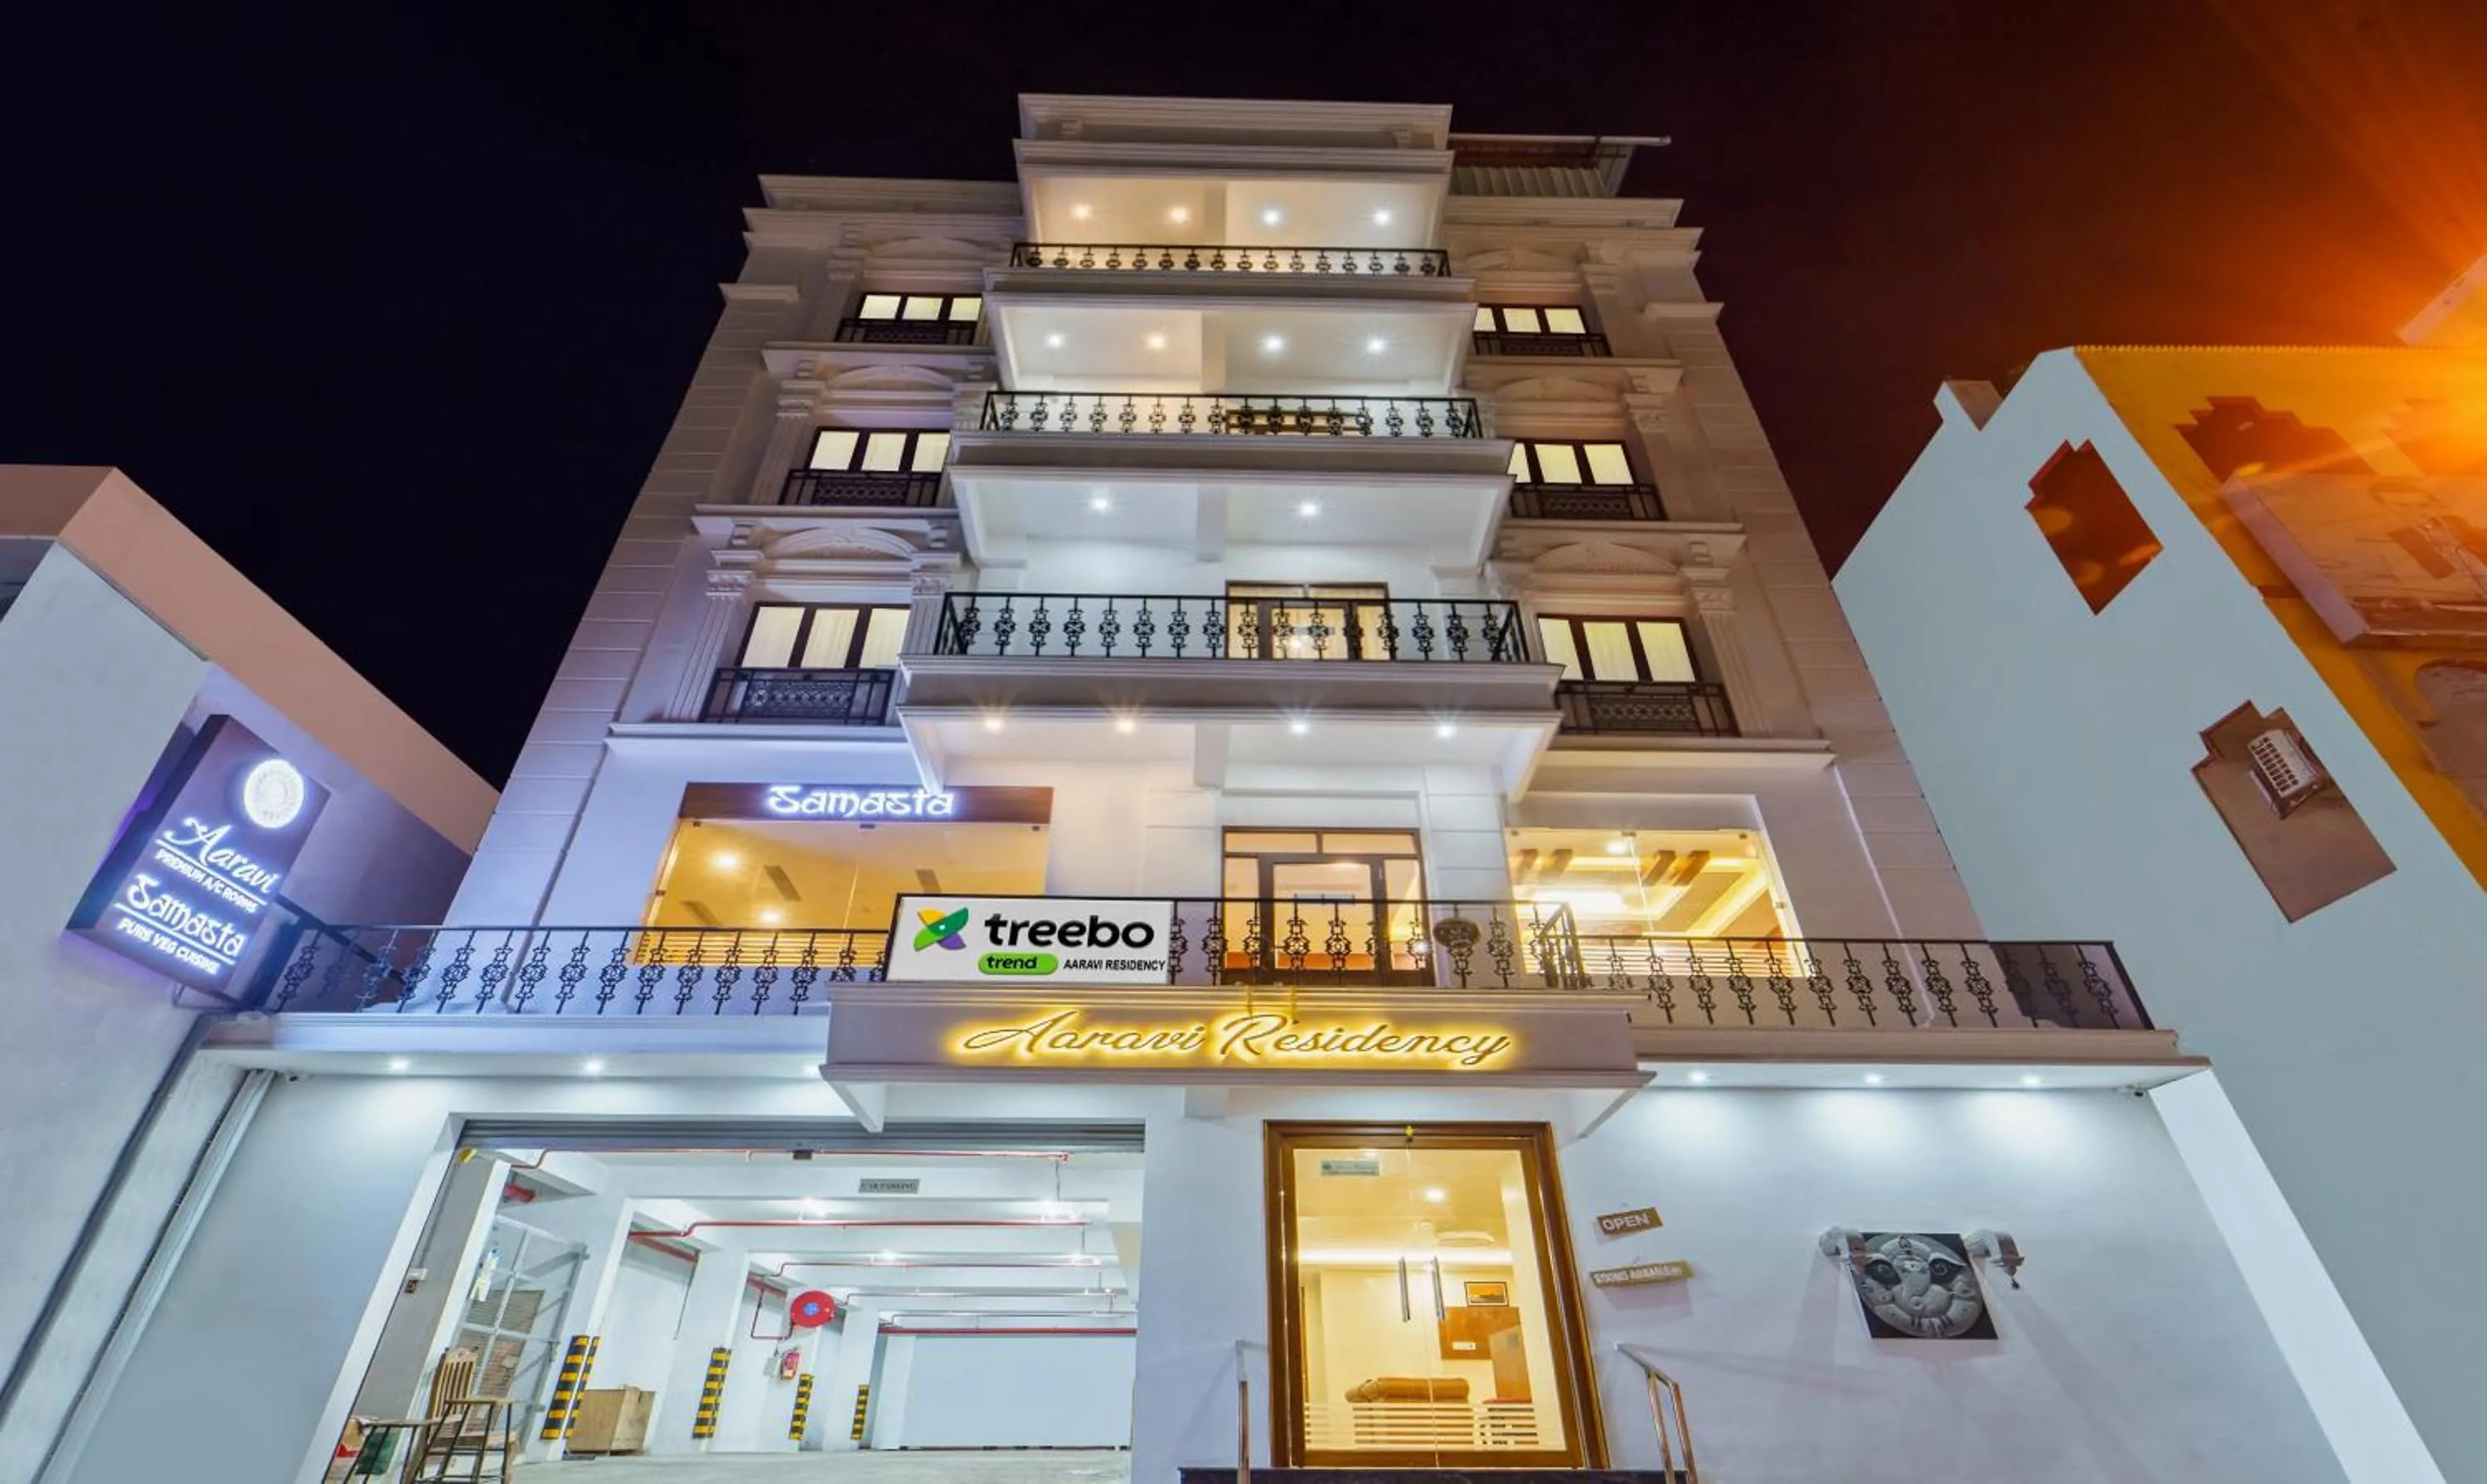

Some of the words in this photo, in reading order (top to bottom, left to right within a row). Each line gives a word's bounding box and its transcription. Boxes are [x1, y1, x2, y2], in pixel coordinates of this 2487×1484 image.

[768, 784, 955, 817] Samasta
[163, 817, 282, 894] Aaravi
[127, 873, 246, 957] Samasta
[984, 914, 1155, 948] treebo
[987, 956, 1037, 970] trend
[1064, 958, 1103, 970] AARAVI
[1105, 959, 1166, 971] RESIDENCY
[963, 1010, 1207, 1055] Aaravi
[1218, 1014, 1512, 1066] Residency
[1602, 1213, 1651, 1231] OPEN
